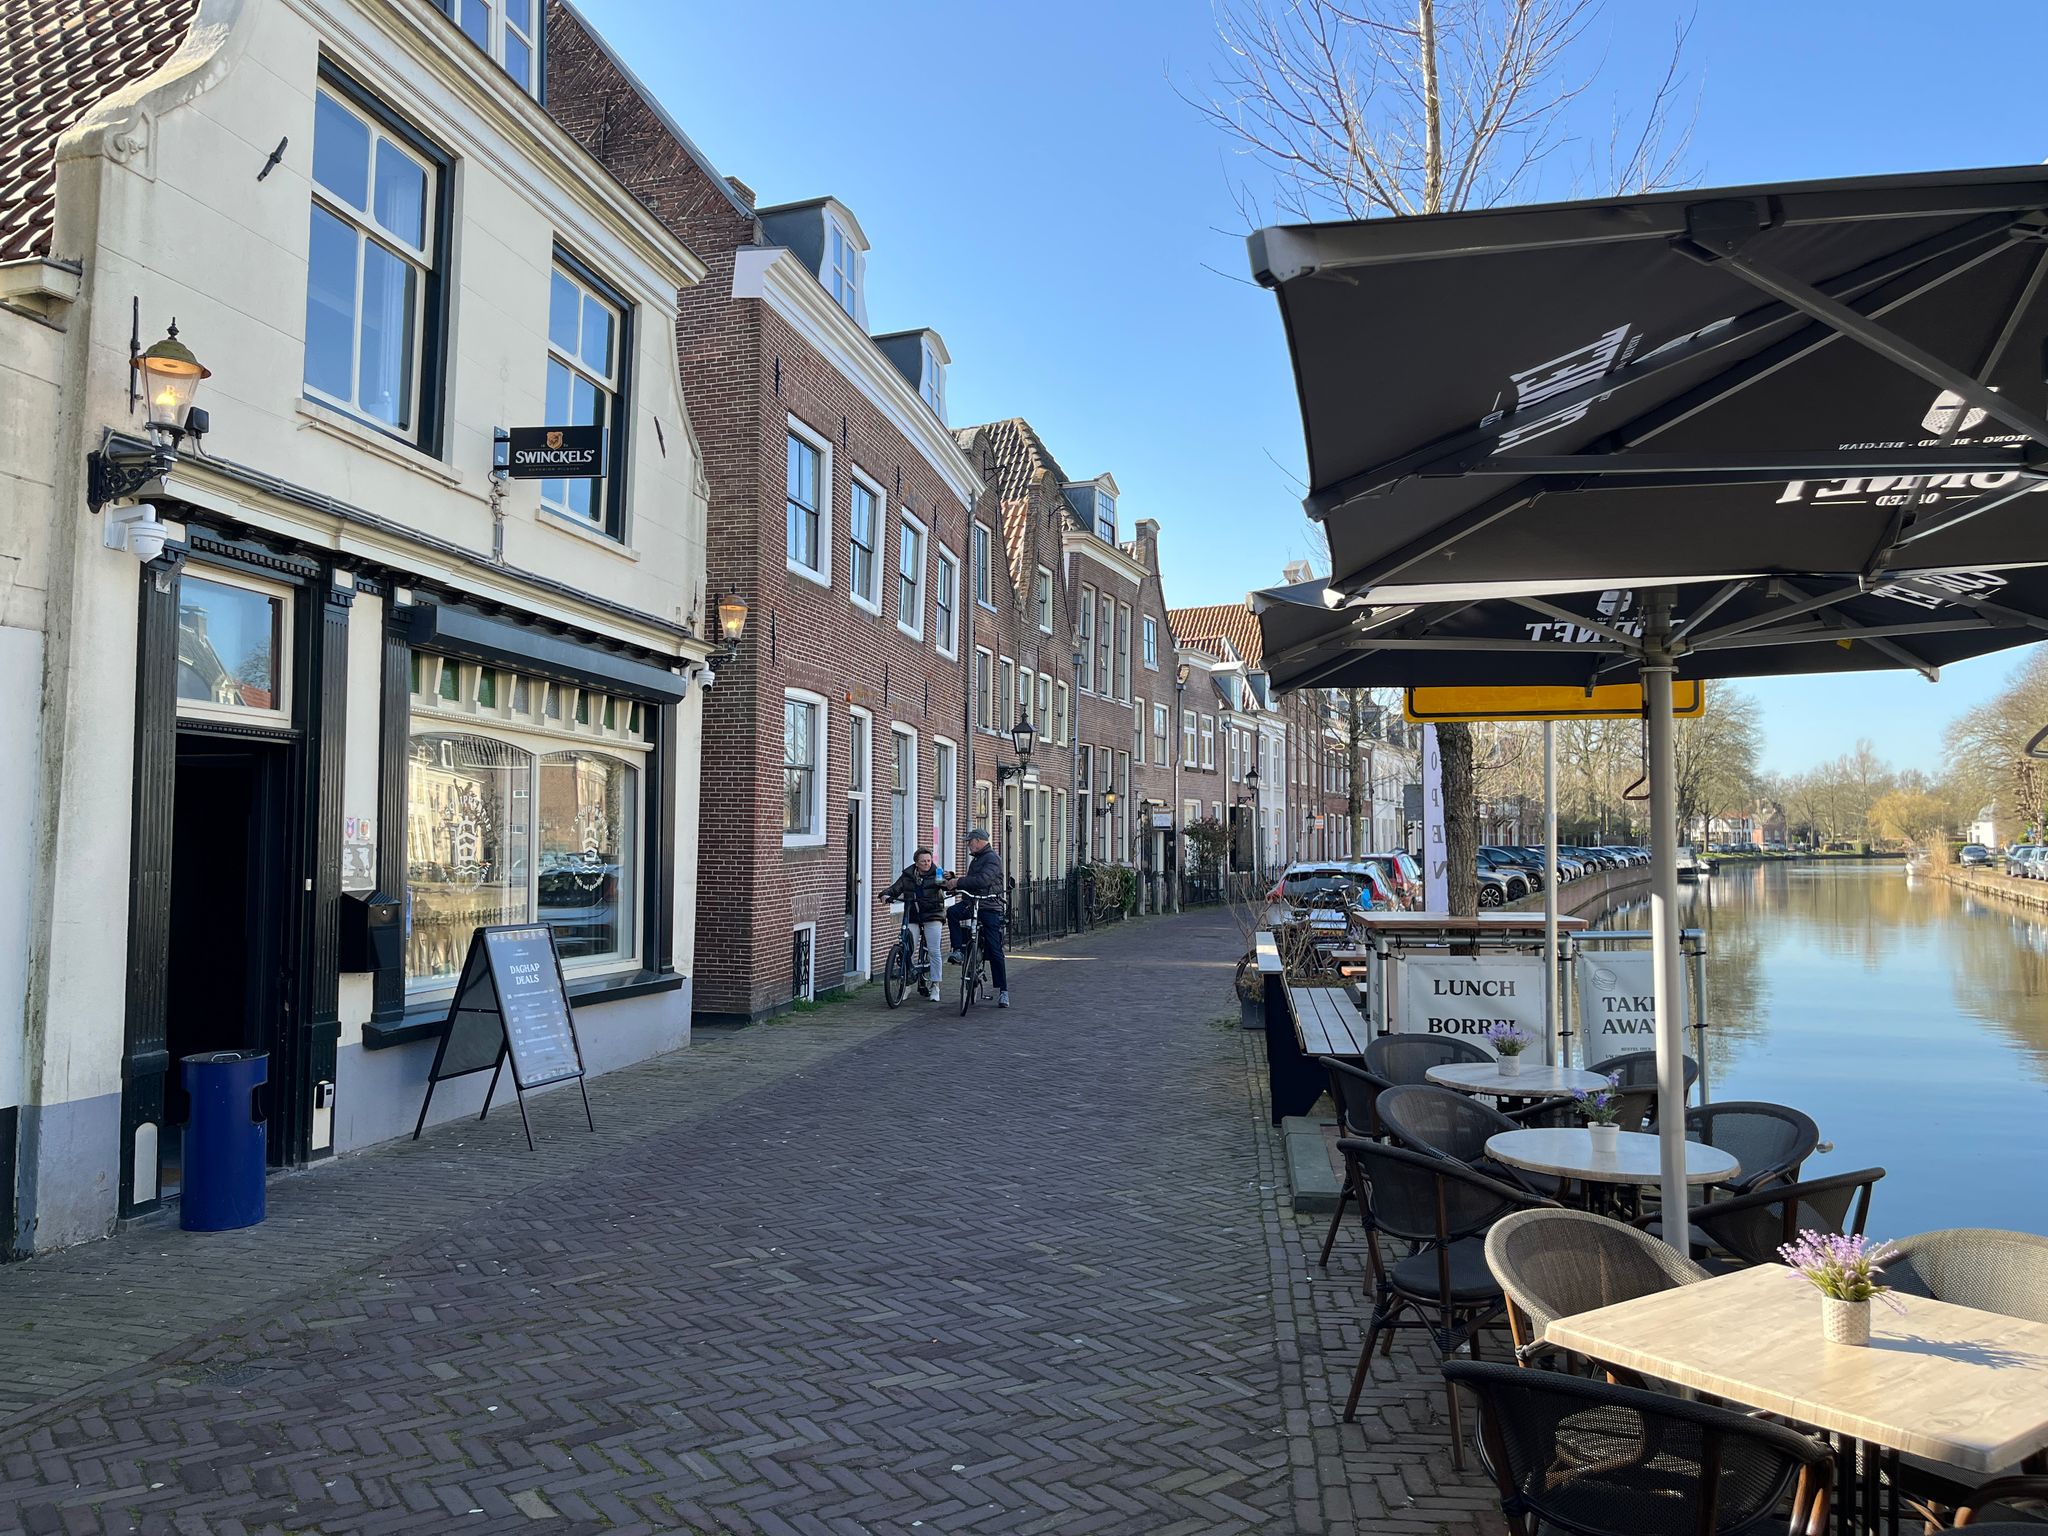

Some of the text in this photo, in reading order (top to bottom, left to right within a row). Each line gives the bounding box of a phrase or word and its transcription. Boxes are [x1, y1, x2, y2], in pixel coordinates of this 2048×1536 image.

[509, 962, 541, 975] DAGHAP
[515, 974, 540, 986] DEALS
[1433, 979, 1516, 997] LUNCH
[1602, 1018, 1655, 1035] AWA
